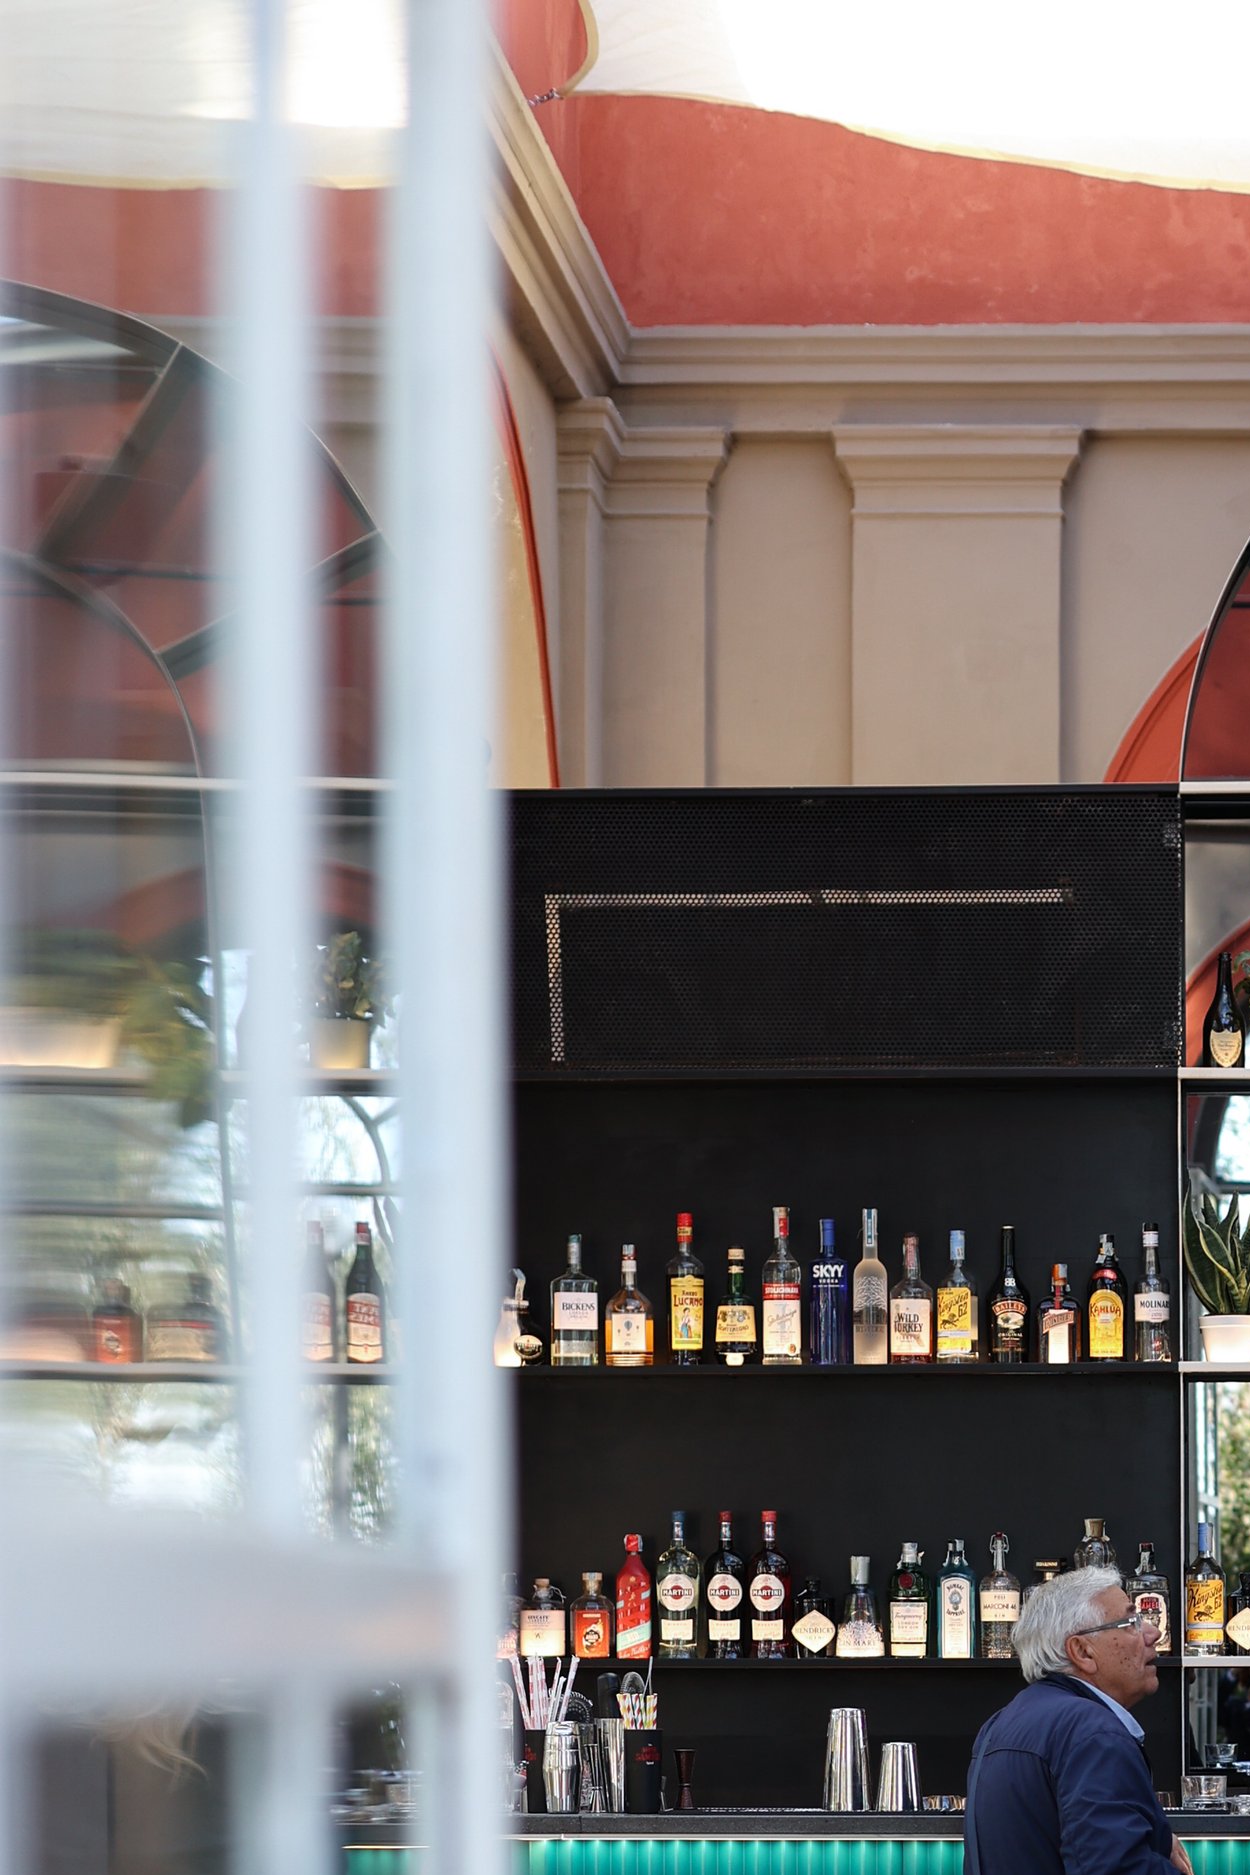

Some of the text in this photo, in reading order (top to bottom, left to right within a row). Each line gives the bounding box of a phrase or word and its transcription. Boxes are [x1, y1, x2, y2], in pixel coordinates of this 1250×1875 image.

[812, 1264, 844, 1278] SKYY
[562, 1302, 596, 1311] BICKENS
[958, 1302, 968, 1318] 62
[896, 1313, 920, 1322] WILD
[894, 1323, 923, 1333] TURKEY
